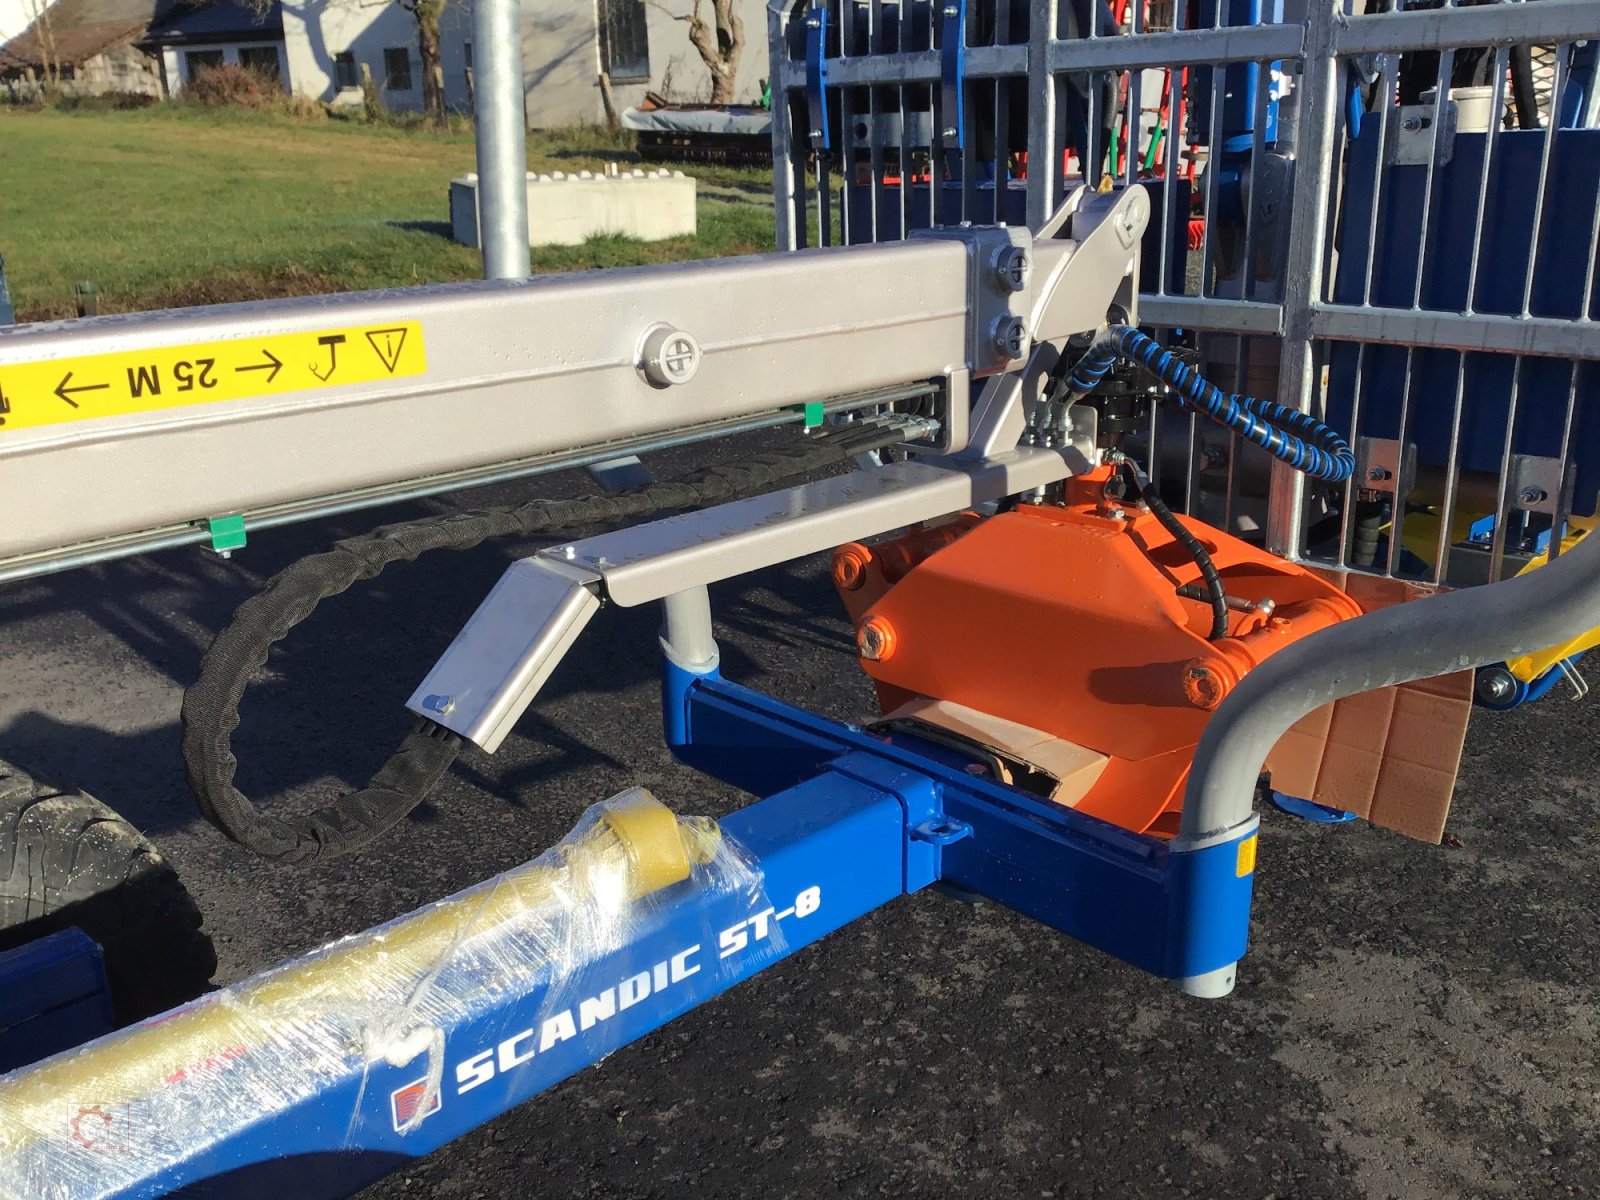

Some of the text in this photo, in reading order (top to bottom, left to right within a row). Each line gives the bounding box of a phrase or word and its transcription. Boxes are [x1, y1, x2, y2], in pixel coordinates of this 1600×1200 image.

[126, 358, 218, 398] 25 M
[456, 886, 821, 1095] SCANDIC ST-8
